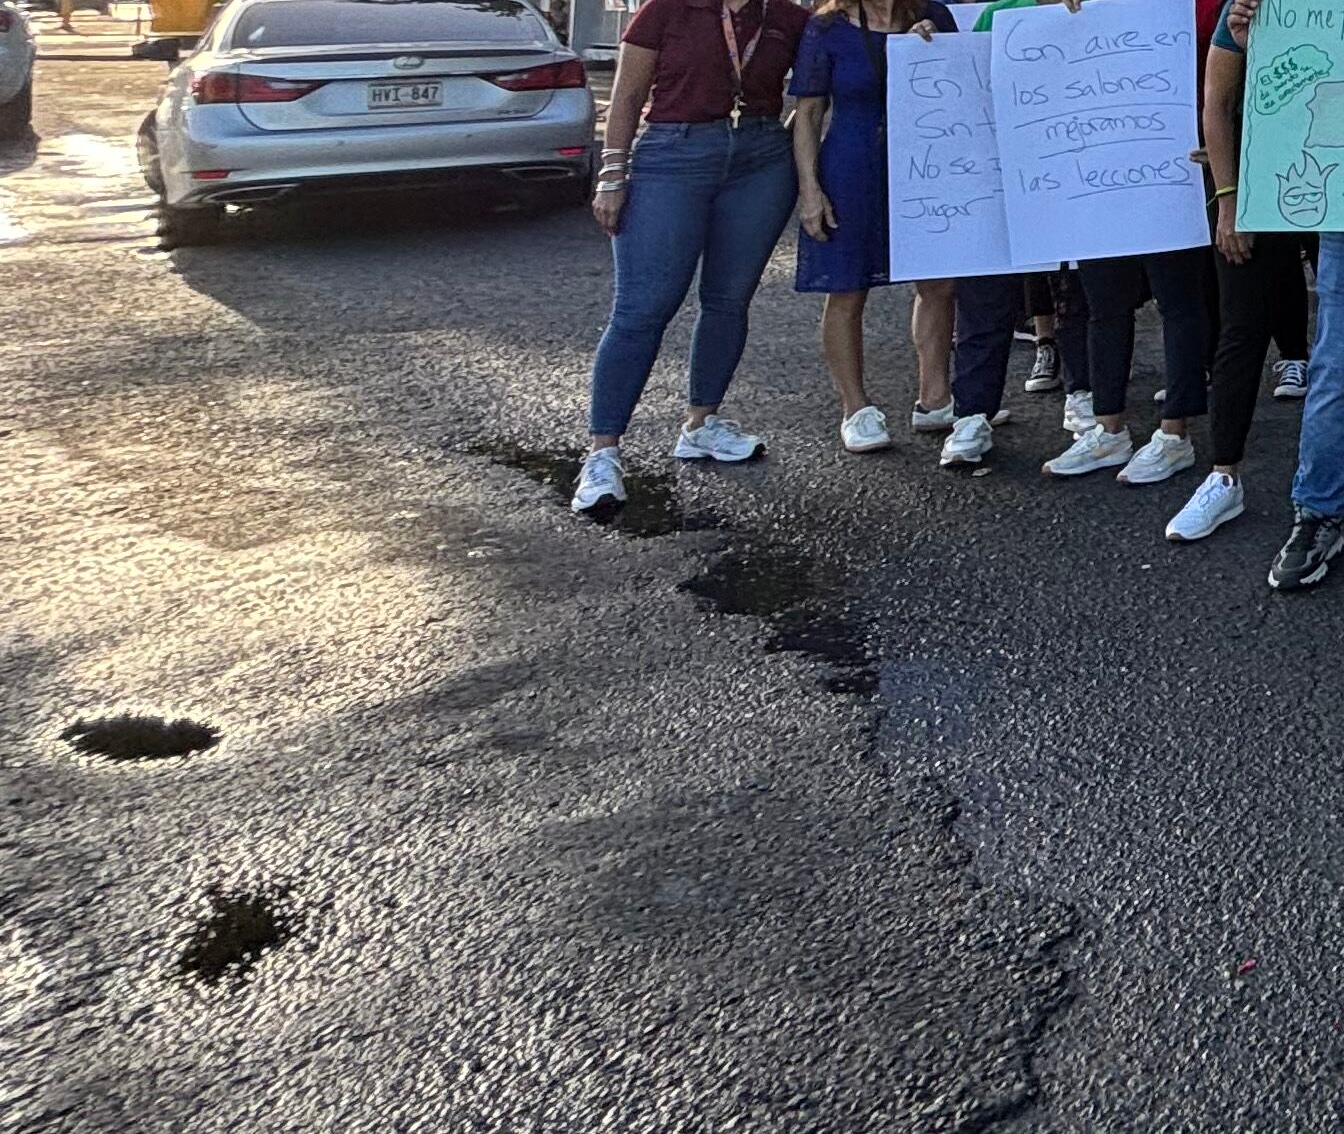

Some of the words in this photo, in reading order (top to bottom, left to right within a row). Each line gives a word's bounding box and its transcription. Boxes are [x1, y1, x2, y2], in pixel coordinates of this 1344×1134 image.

[1307, 7, 1335, 29] me
[1004, 18, 1066, 63] Con
[1085, 30, 1149, 56] aire
[1154, 30, 1192, 47] en
[907, 57, 962, 98] En
[1012, 80, 1050, 107] los
[1064, 68, 1179, 98] salones,
[914, 108, 973, 139] Sin
[1045, 112, 1167, 154] mejoramos
[908, 144, 941, 181] No
[949, 157, 983, 176] se
[1018, 169, 1061, 195] las
[1075, 156, 1193, 188] lecciones
[899, 195, 995, 234] Jugar
